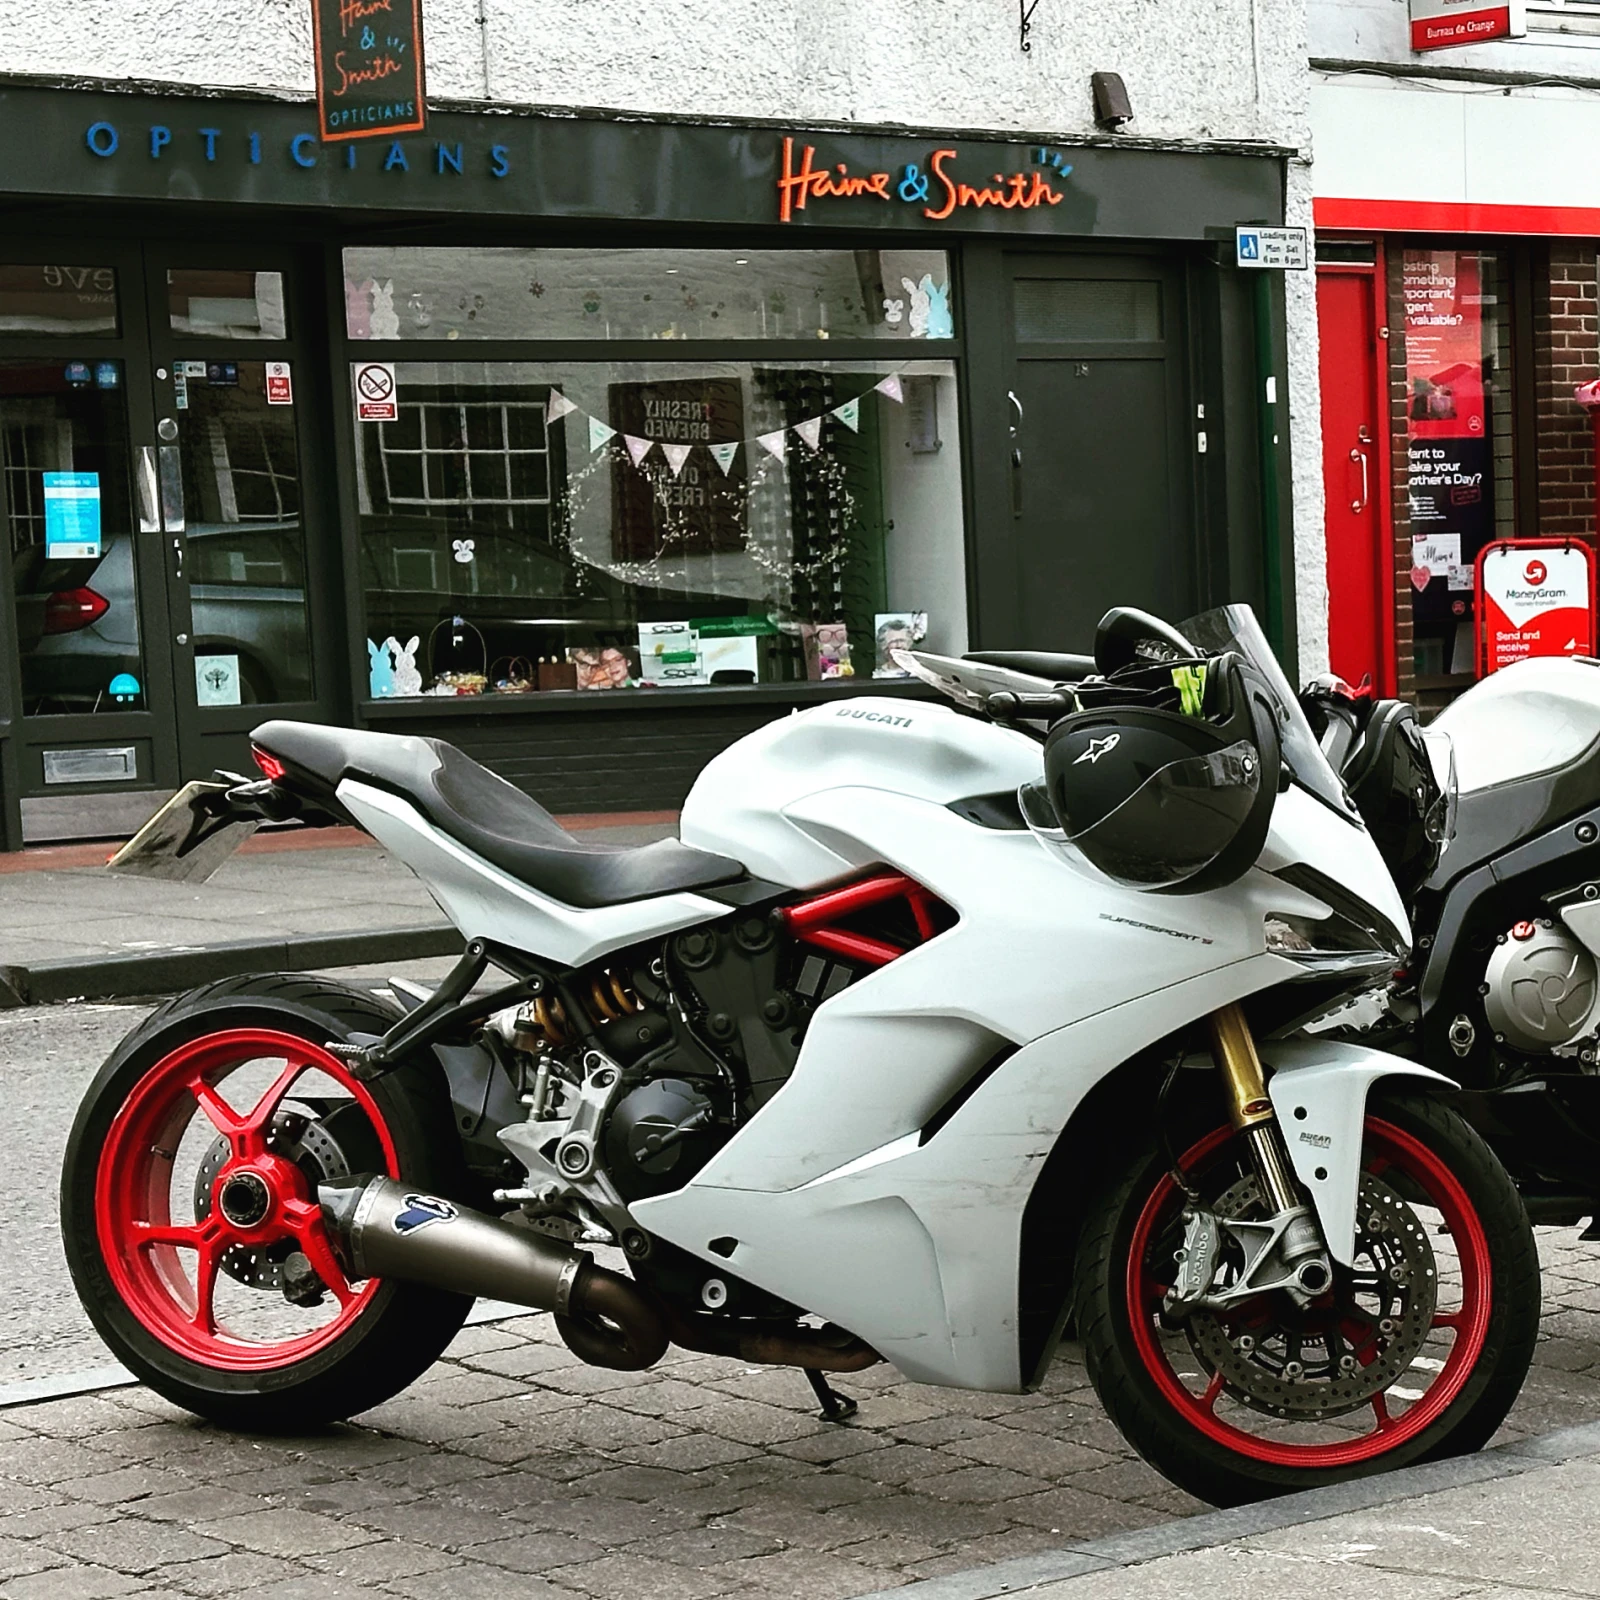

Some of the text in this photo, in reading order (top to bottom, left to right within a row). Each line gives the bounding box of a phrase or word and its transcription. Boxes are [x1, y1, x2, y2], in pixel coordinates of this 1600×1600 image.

[1426, 20, 1495, 39] Bureau de Change
[360, 25, 375, 50] &
[333, 50, 402, 96] Smith
[329, 101, 414, 126] OPTICIANS
[86, 122, 511, 178] OPTICIANS
[777, 137, 1065, 222] Haine & Smith
[1260, 231, 1303, 242] Loading only
[1265, 244, 1299, 253] Mon Sat
[1410, 314, 1463, 326] valuable?
[1432, 448, 1446, 459] to
[1433, 463, 1461, 474] your
[1453, 473, 1483, 487] Day?
[1505, 588, 1566, 600] MoneyGram
[1496, 630, 1541, 641] Send and
[1496, 642, 1530, 652] receive
[836, 708, 914, 728] DUCATI
[1099, 913, 1201, 941] SUPERSPORT
[1299, 1131, 1332, 1144] DUCATI
[1187, 1232, 1209, 1285] brembo
